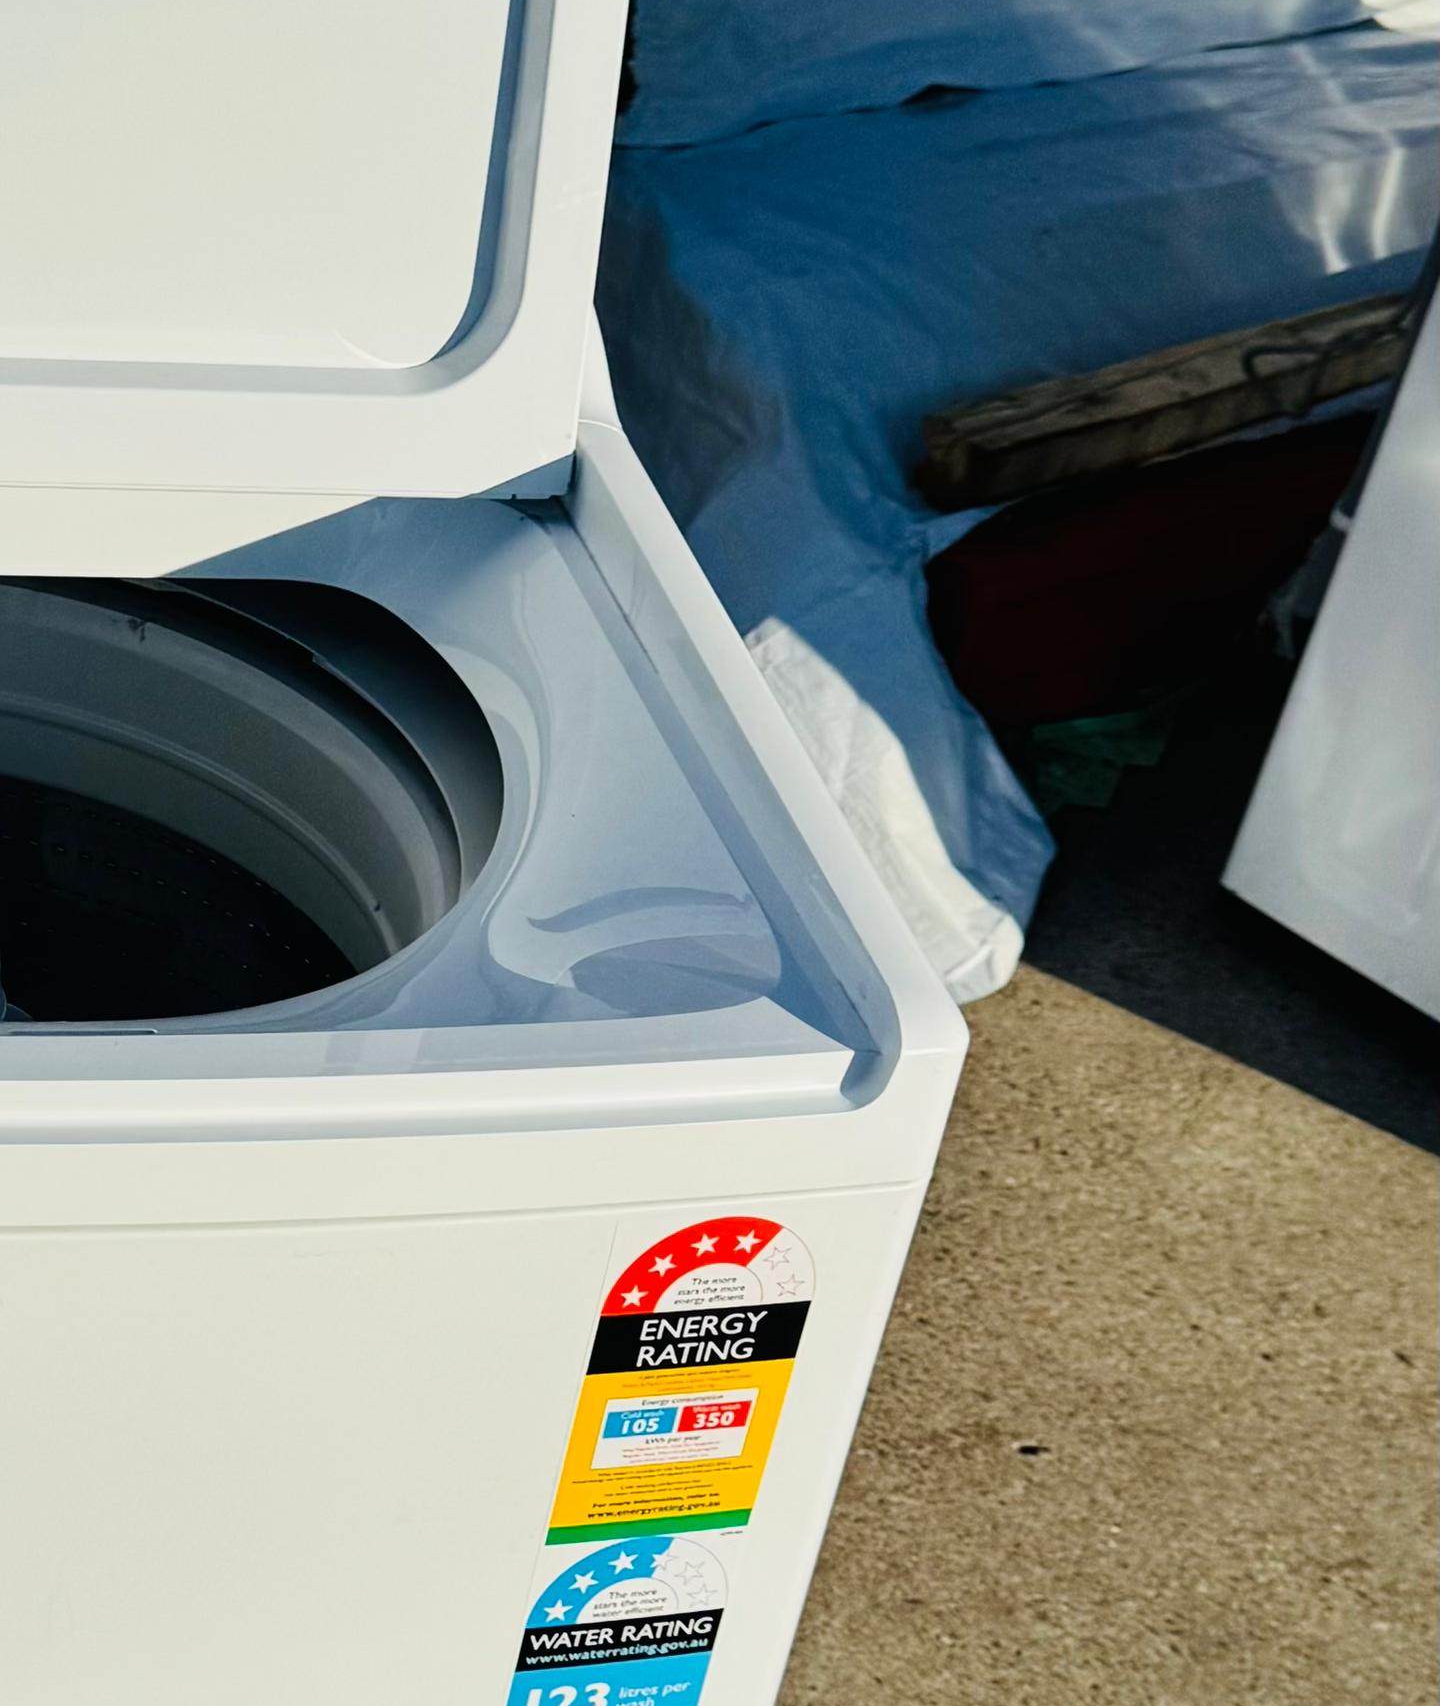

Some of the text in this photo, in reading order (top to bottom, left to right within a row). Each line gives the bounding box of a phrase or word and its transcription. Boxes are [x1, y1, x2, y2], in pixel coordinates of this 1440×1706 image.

[691, 1276, 737, 1286] The more
[677, 1284, 746, 1296] stars the more
[674, 1294, 745, 1305] energy efficient
[639, 1310, 768, 1341] ENERGY
[636, 1337, 756, 1367] RATING
[621, 1417, 660, 1434] 105
[692, 1411, 735, 1429] 350
[609, 1589, 658, 1599] The more
[592, 1605, 665, 1618] water efficient
[593, 1596, 667, 1610] stars the more
[530, 1617, 714, 1651] WATER RATING
[525, 1638, 709, 1665] www.waterrating.gov.au
[618, 1681, 692, 1700] litres per
